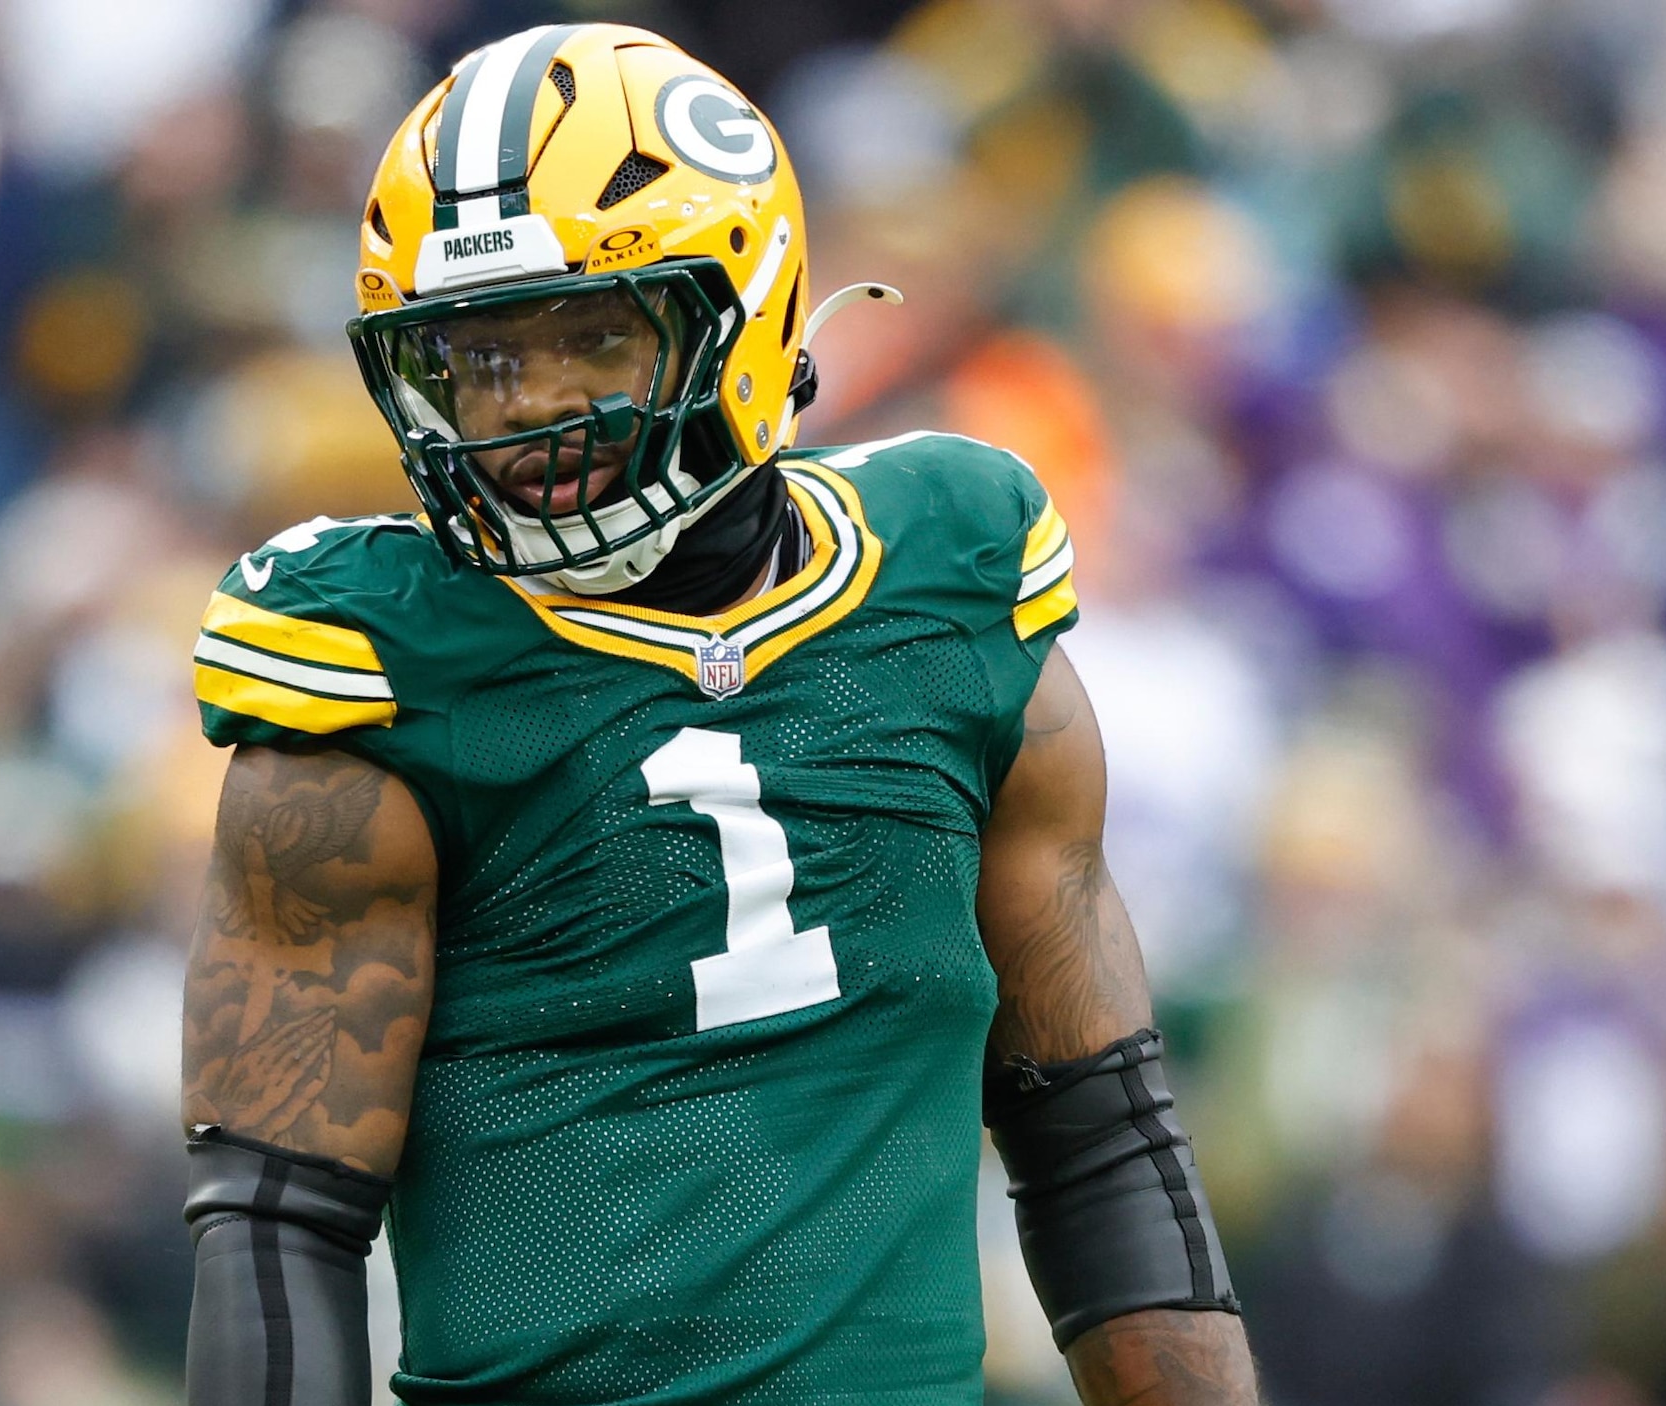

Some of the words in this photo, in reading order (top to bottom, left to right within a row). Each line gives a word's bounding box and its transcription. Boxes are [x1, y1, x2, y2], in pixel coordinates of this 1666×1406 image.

[664, 80, 774, 176] G
[443, 229, 515, 262] PACKERS
[592, 242, 655, 267] OAKLEY
[706, 664, 737, 690] NFL
[640, 726, 841, 1032] 1
